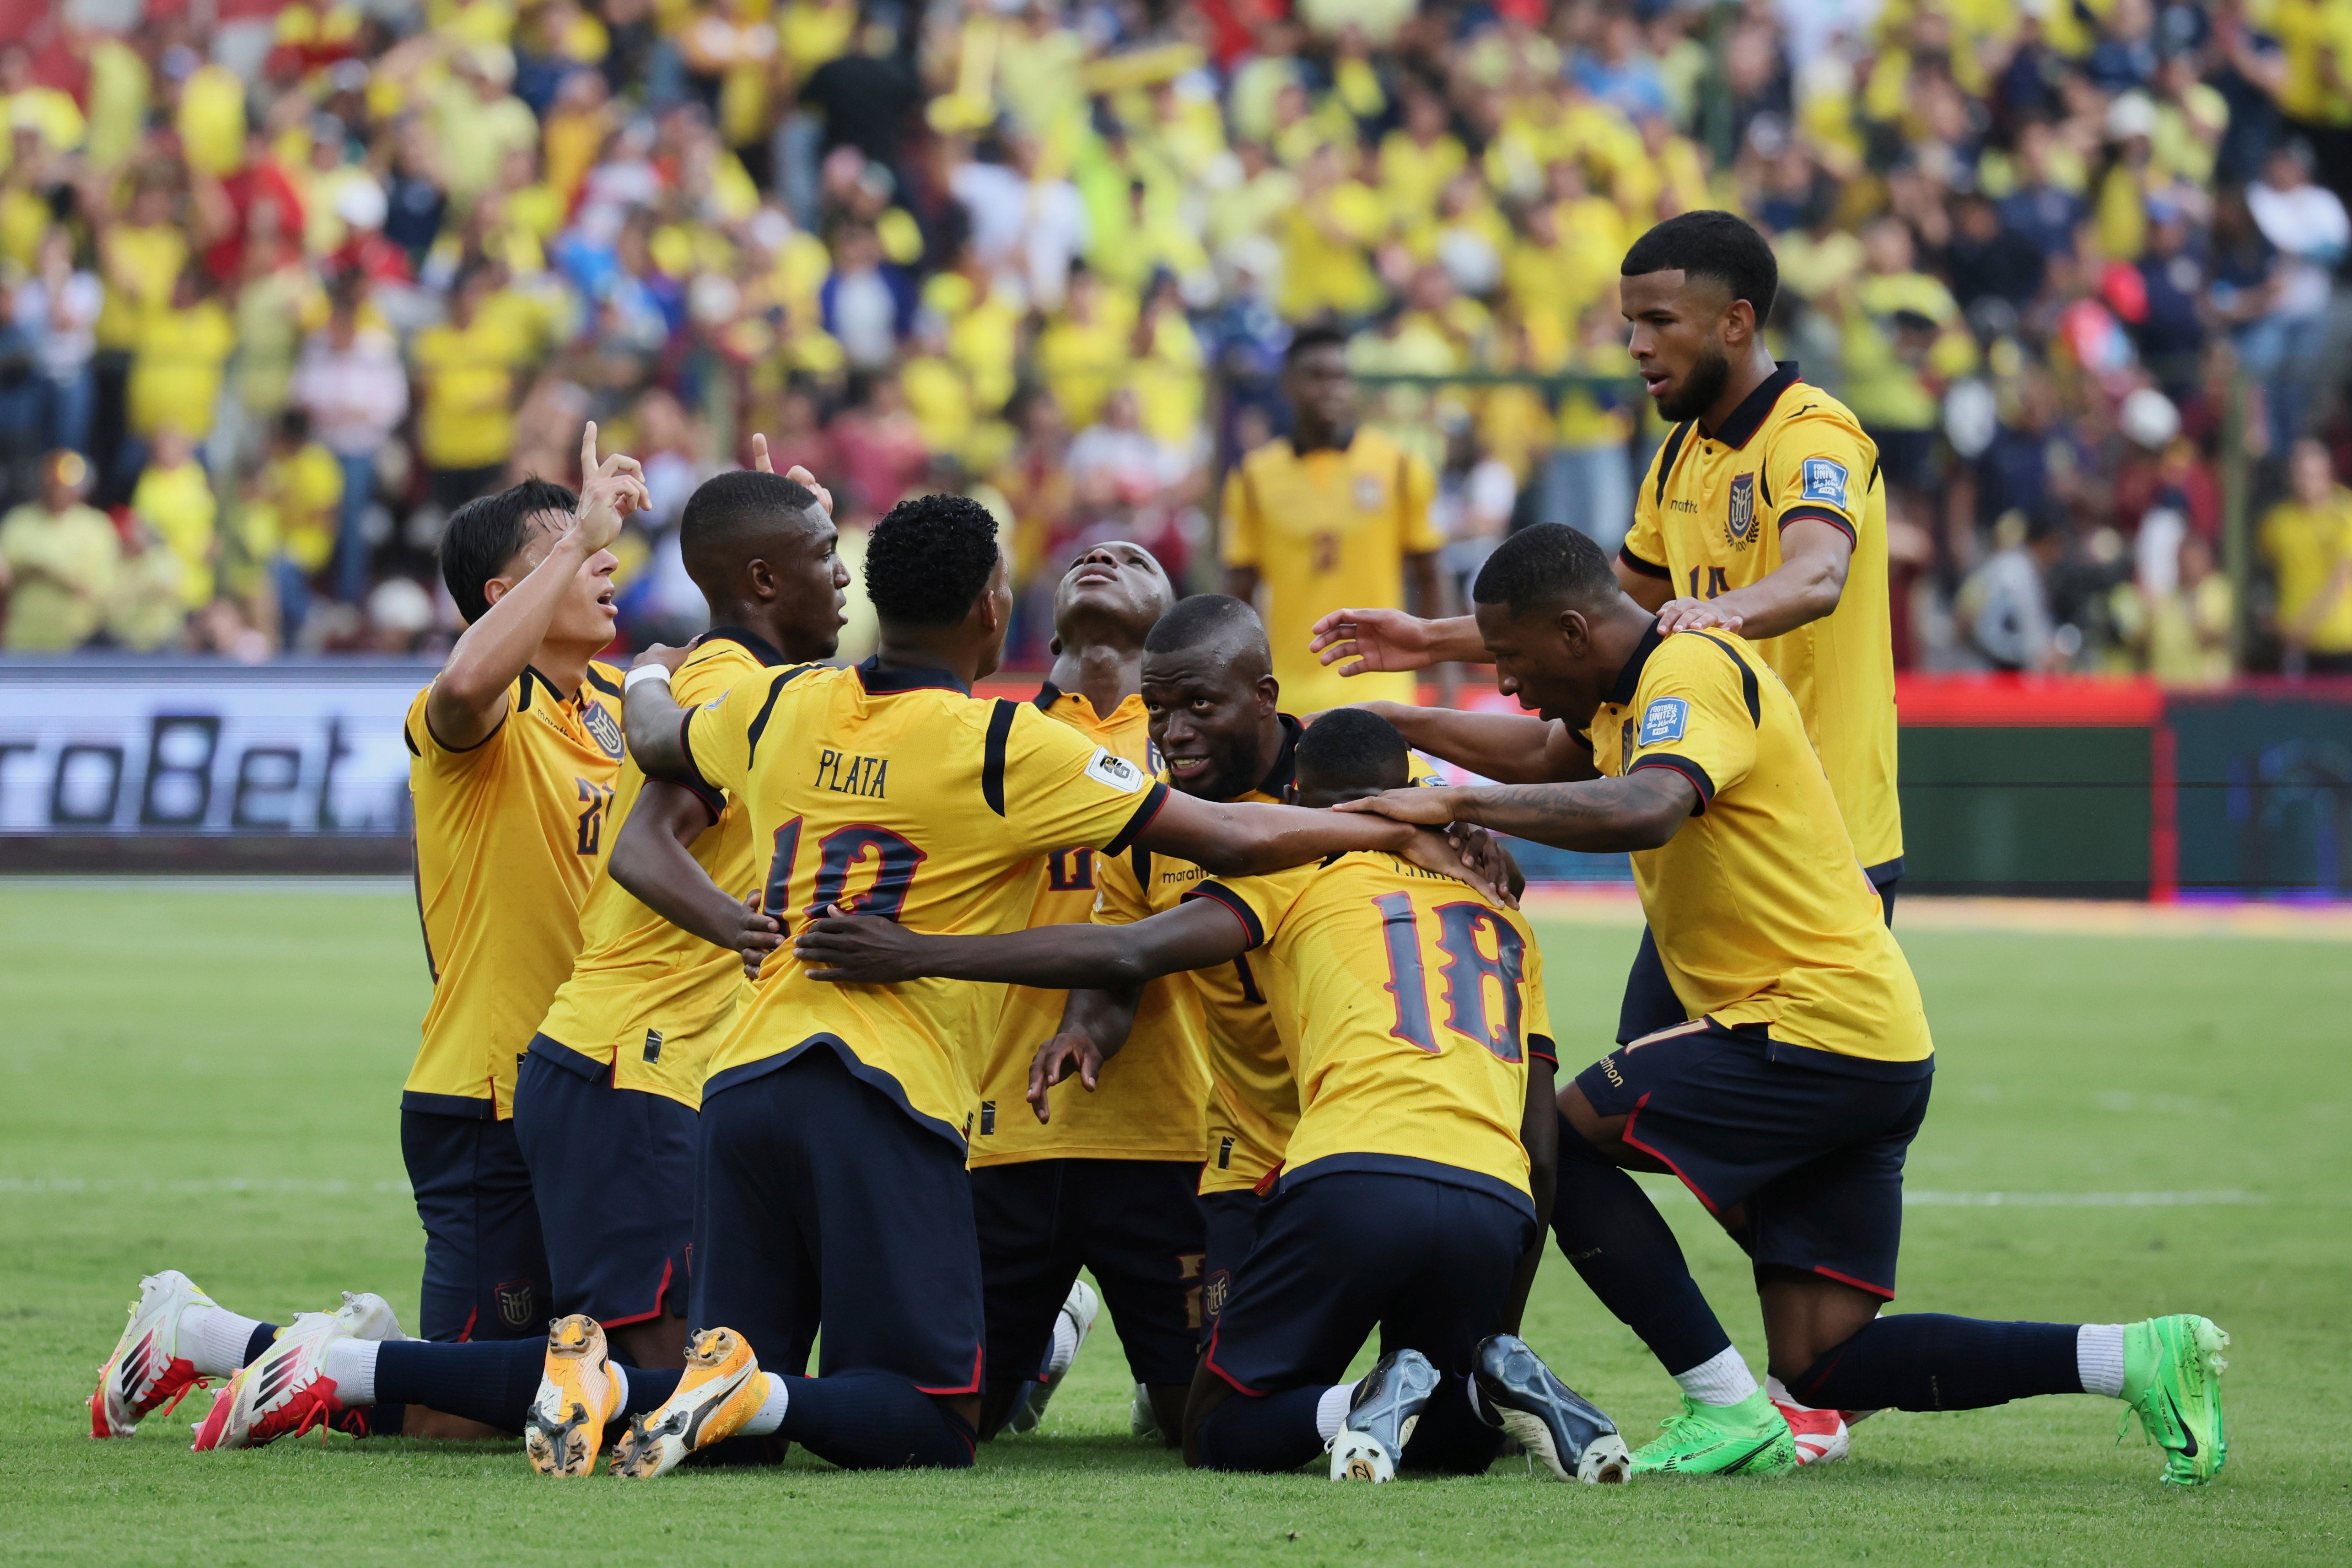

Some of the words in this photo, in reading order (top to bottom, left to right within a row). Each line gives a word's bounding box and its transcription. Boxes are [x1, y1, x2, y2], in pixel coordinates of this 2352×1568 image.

[1650, 703, 1678, 713] FOOTBALL
[1649, 709, 1677, 722] UNITES
[1646, 721, 1657, 730] the
[1658, 717, 1678, 727] World
[814, 749, 889, 799] PLATA
[1371, 890, 1527, 1063] 18
